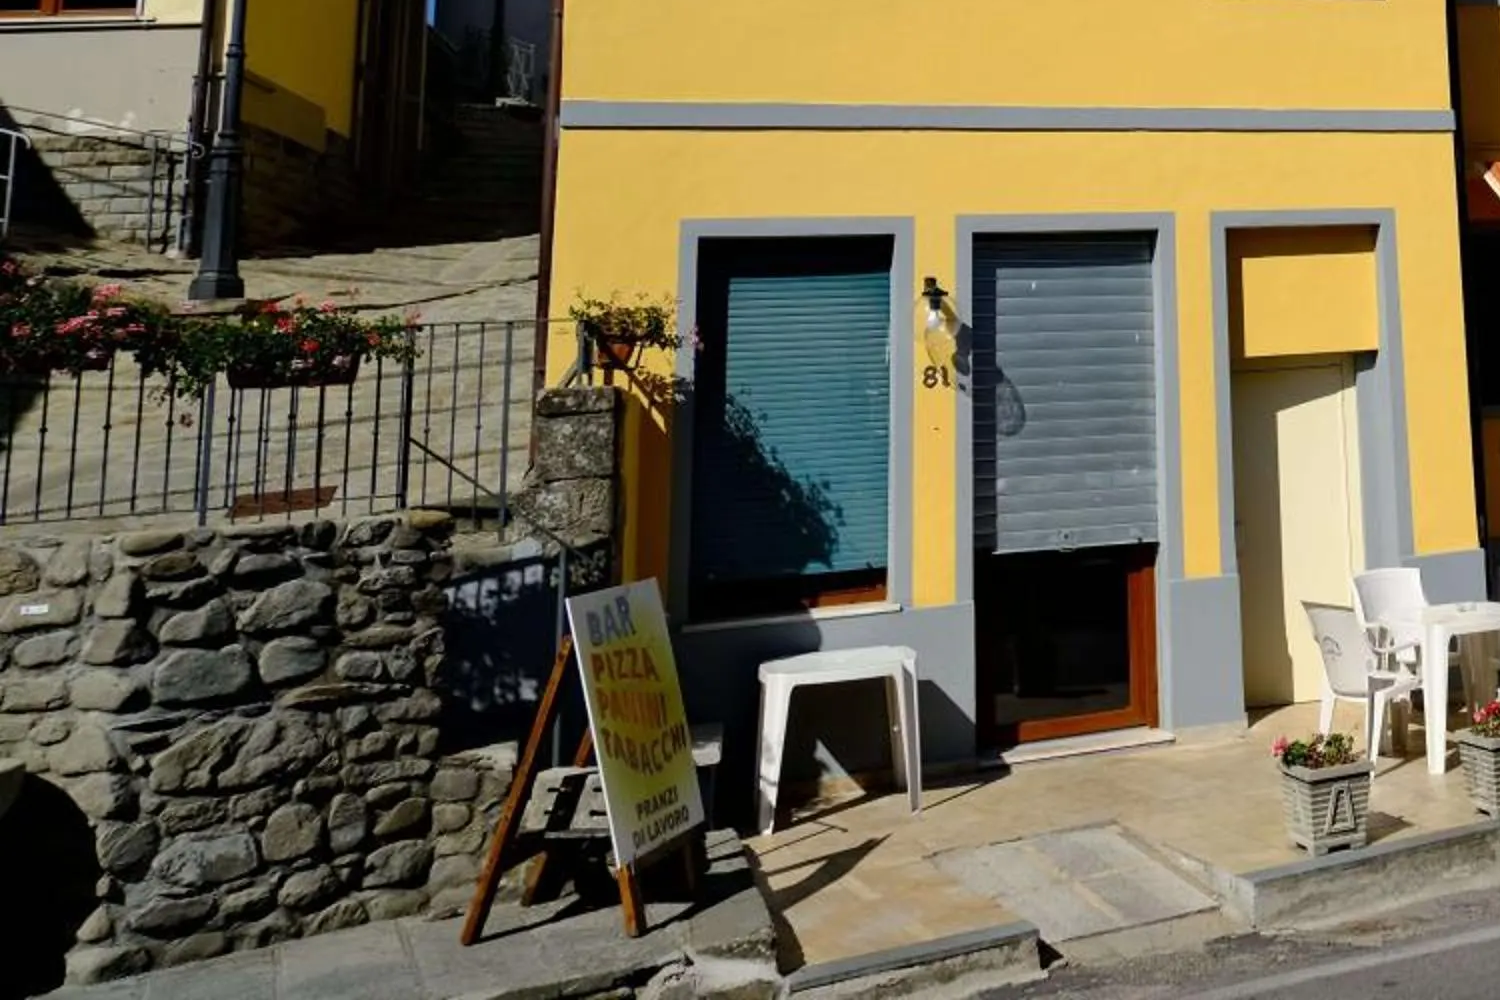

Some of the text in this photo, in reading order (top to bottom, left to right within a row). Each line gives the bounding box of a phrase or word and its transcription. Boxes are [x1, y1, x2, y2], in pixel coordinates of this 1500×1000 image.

[922, 365, 951, 389] 81
[585, 596, 636, 647] BAR
[591, 647, 660, 682] PIZZA
[596, 688, 668, 728] PANINI
[601, 722, 688, 777] TABACCHI
[634, 787, 679, 820] PRANZI
[632, 804, 689, 851] DI LAVORO
